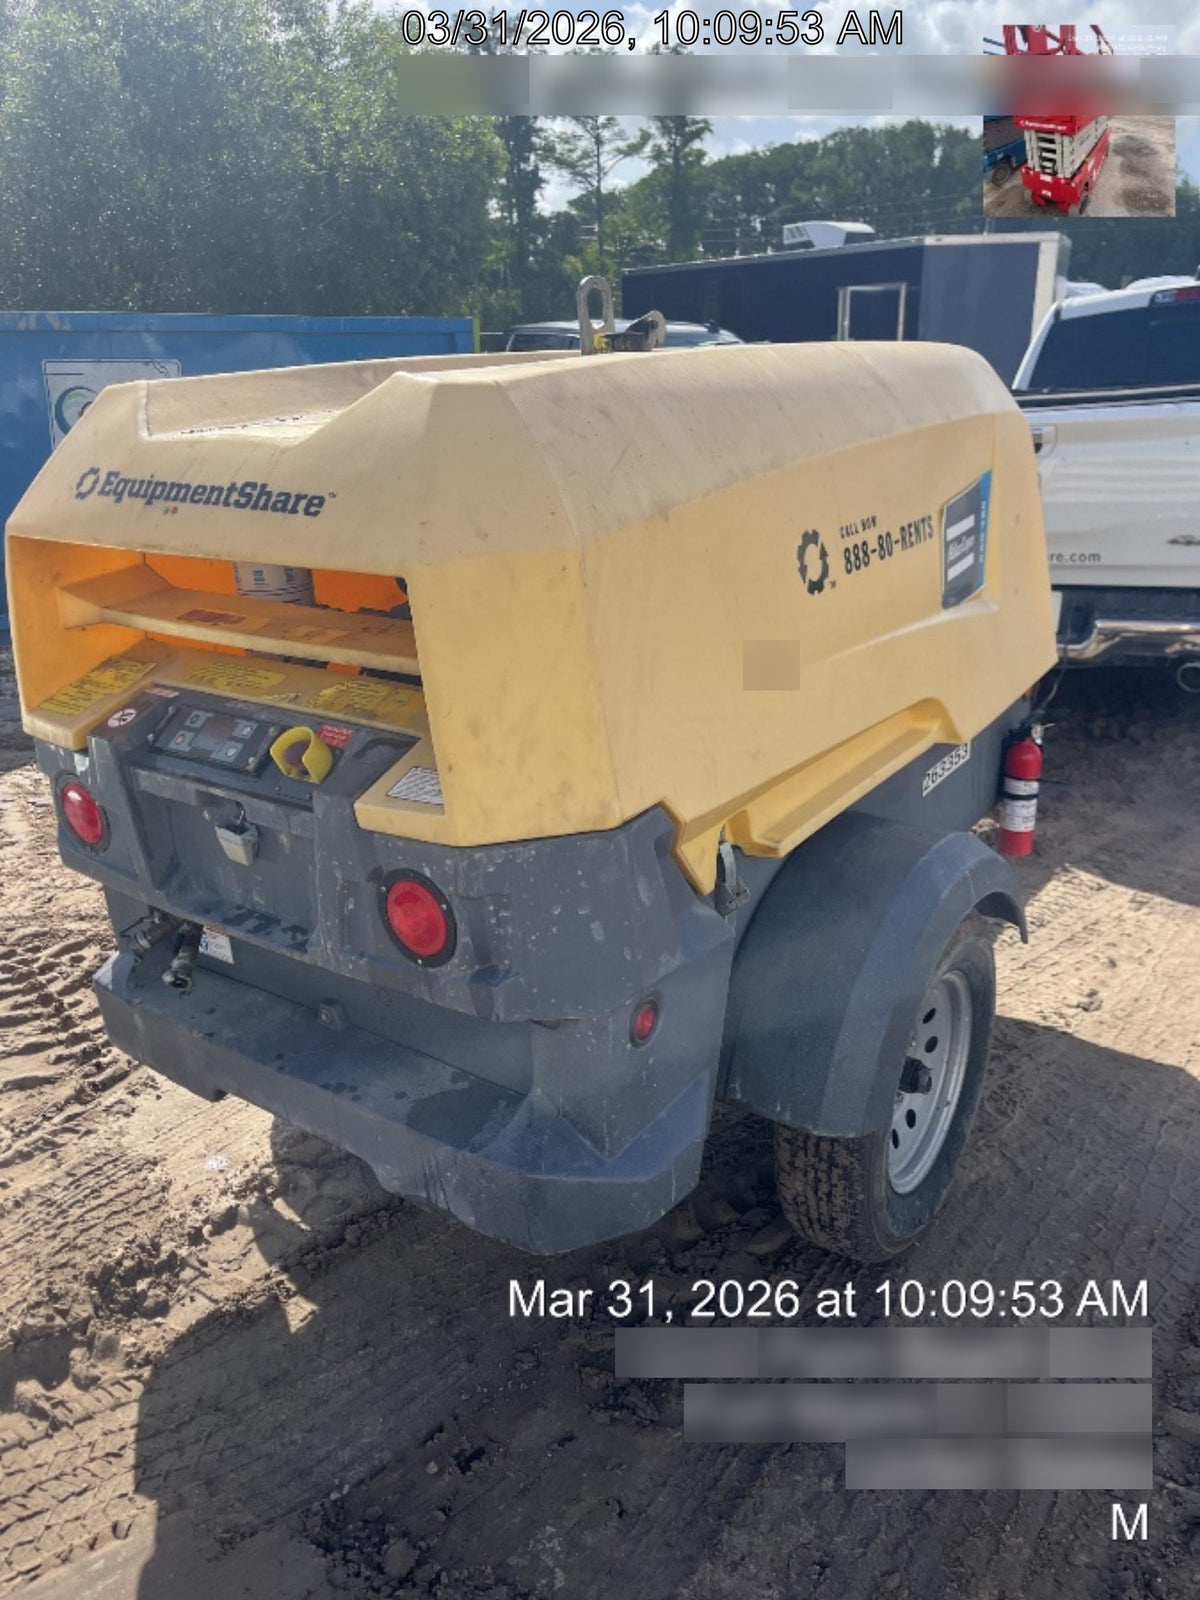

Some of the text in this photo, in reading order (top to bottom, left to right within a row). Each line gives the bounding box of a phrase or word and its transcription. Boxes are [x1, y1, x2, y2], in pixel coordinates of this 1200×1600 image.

[100, 470, 326, 517] EquipmentShare
[840, 523, 859, 540] CALL
[843, 514, 935, 575] 888-80-RENTS
